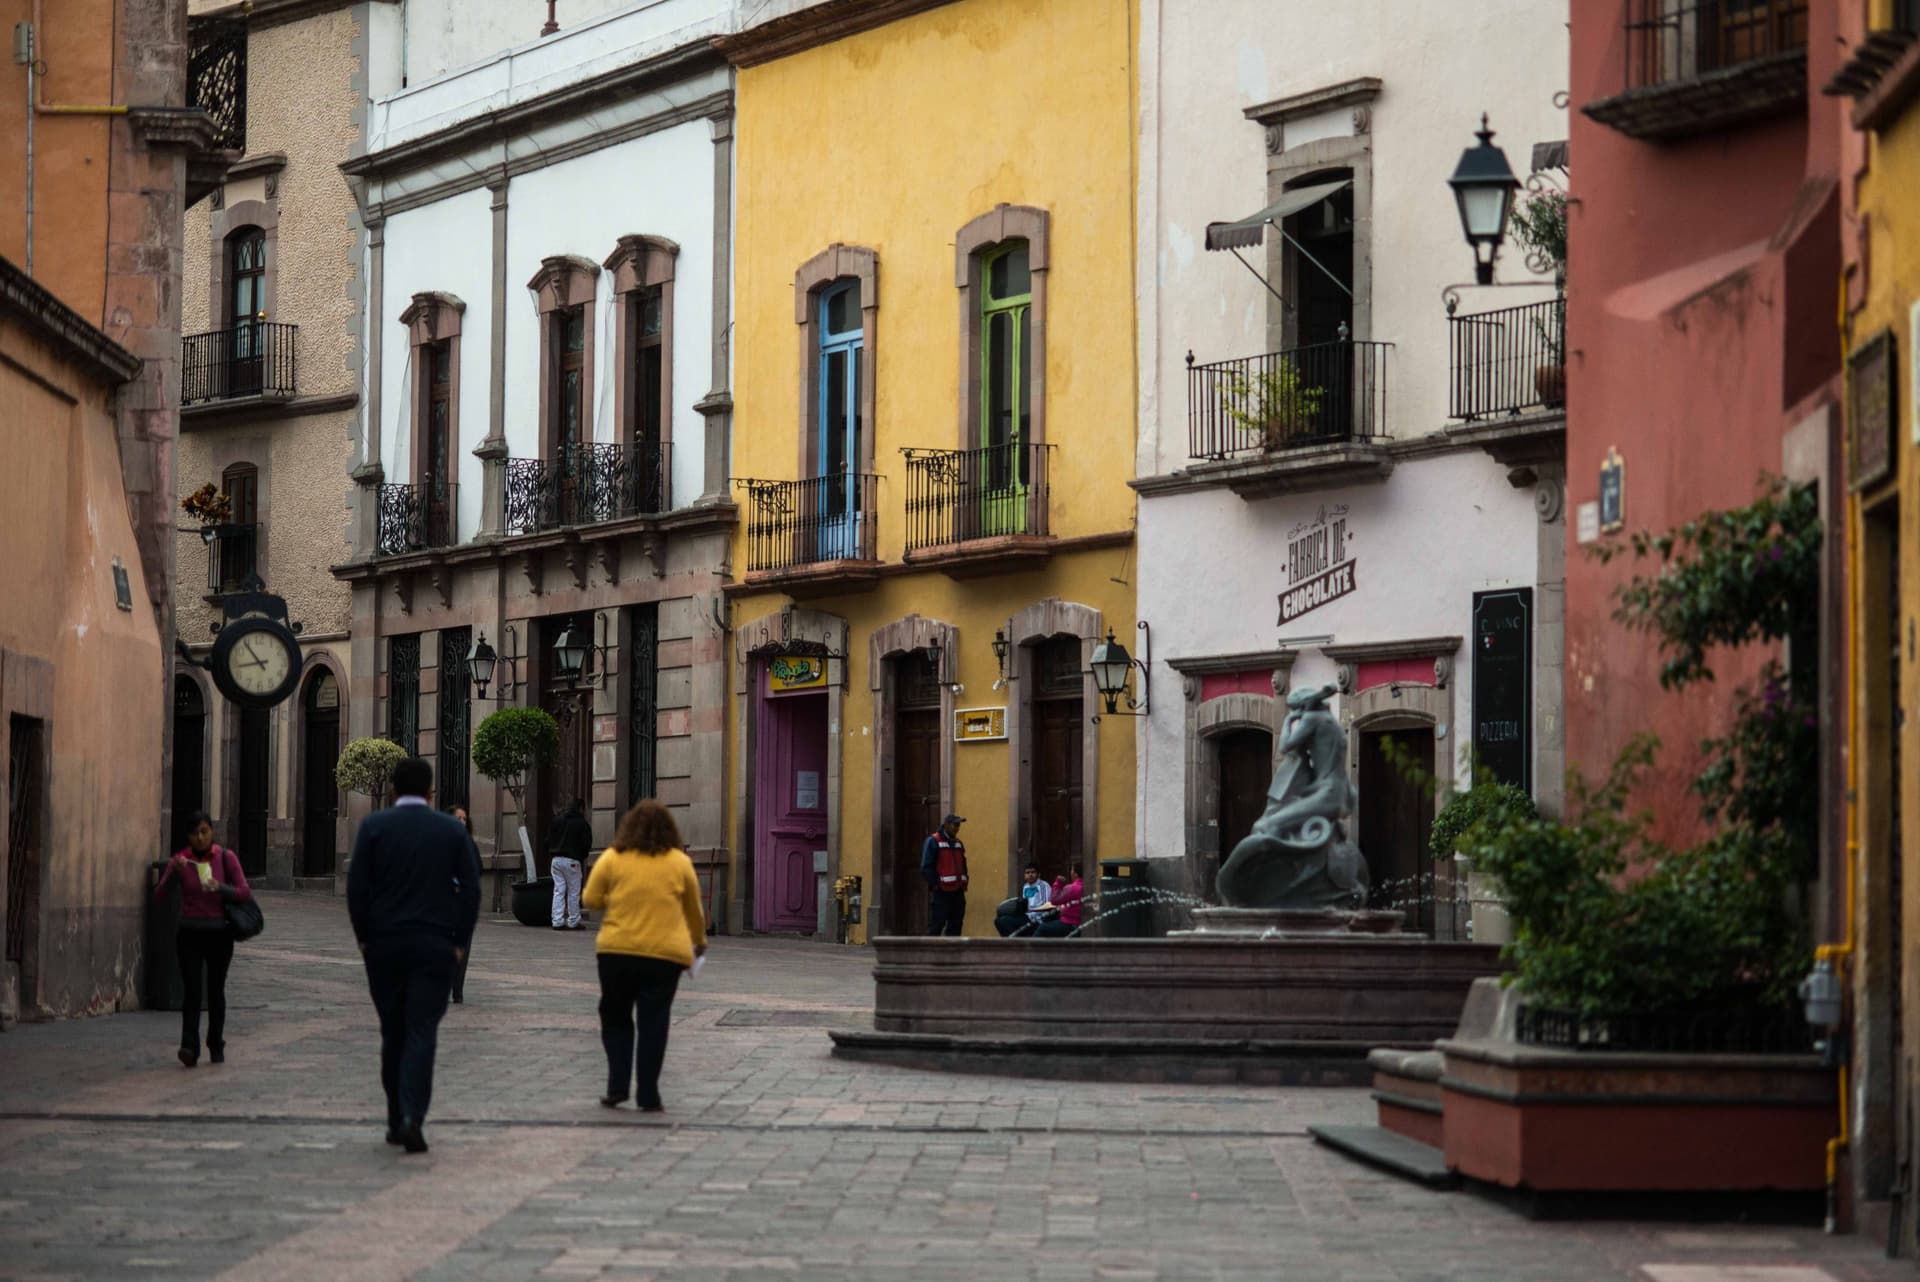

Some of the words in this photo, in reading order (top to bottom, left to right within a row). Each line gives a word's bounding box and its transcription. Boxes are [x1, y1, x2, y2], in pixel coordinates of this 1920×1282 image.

[1333, 518, 1346, 565] DE
[1282, 565, 1351, 619] CHOCOLATE
[255, 634, 264, 645] 12
